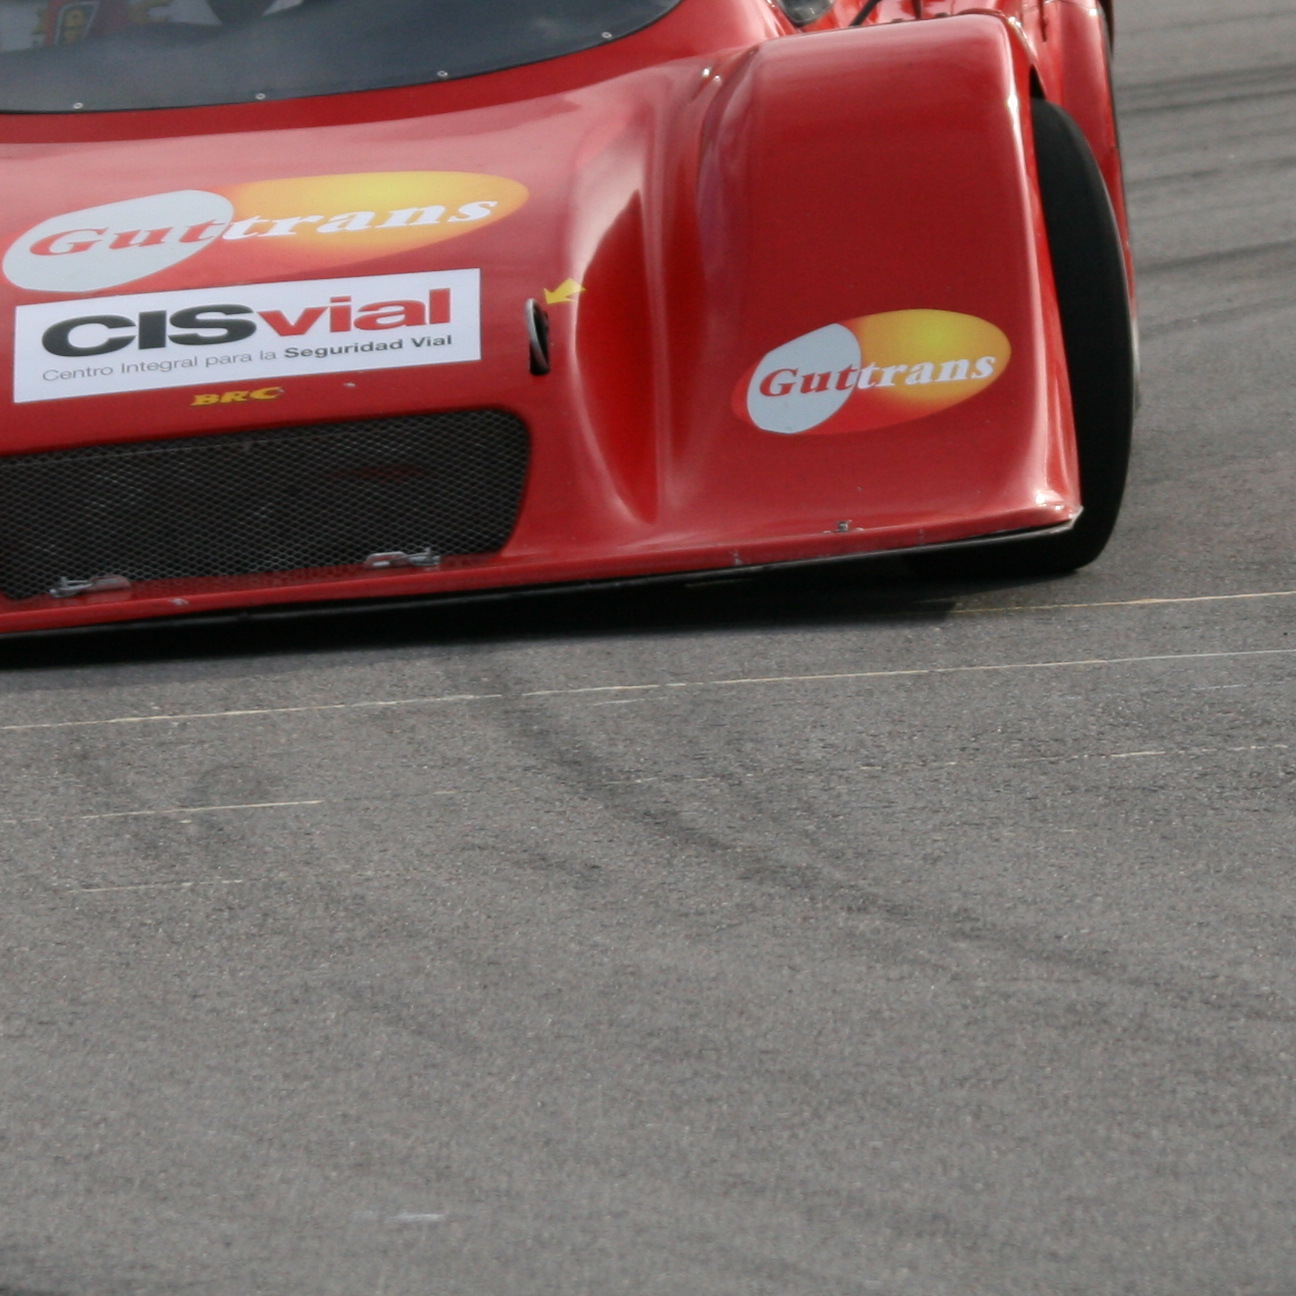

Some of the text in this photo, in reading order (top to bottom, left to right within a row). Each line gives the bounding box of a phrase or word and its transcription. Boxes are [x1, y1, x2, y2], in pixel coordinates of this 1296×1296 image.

[29, 196, 497, 257] Guttrans
[42, 288, 451, 357] CISvial
[42, 335, 452, 382] Centro Integral para la Seguridad Vial
[759, 353, 997, 398] Guttrans
[191, 387, 283, 407] BRC
